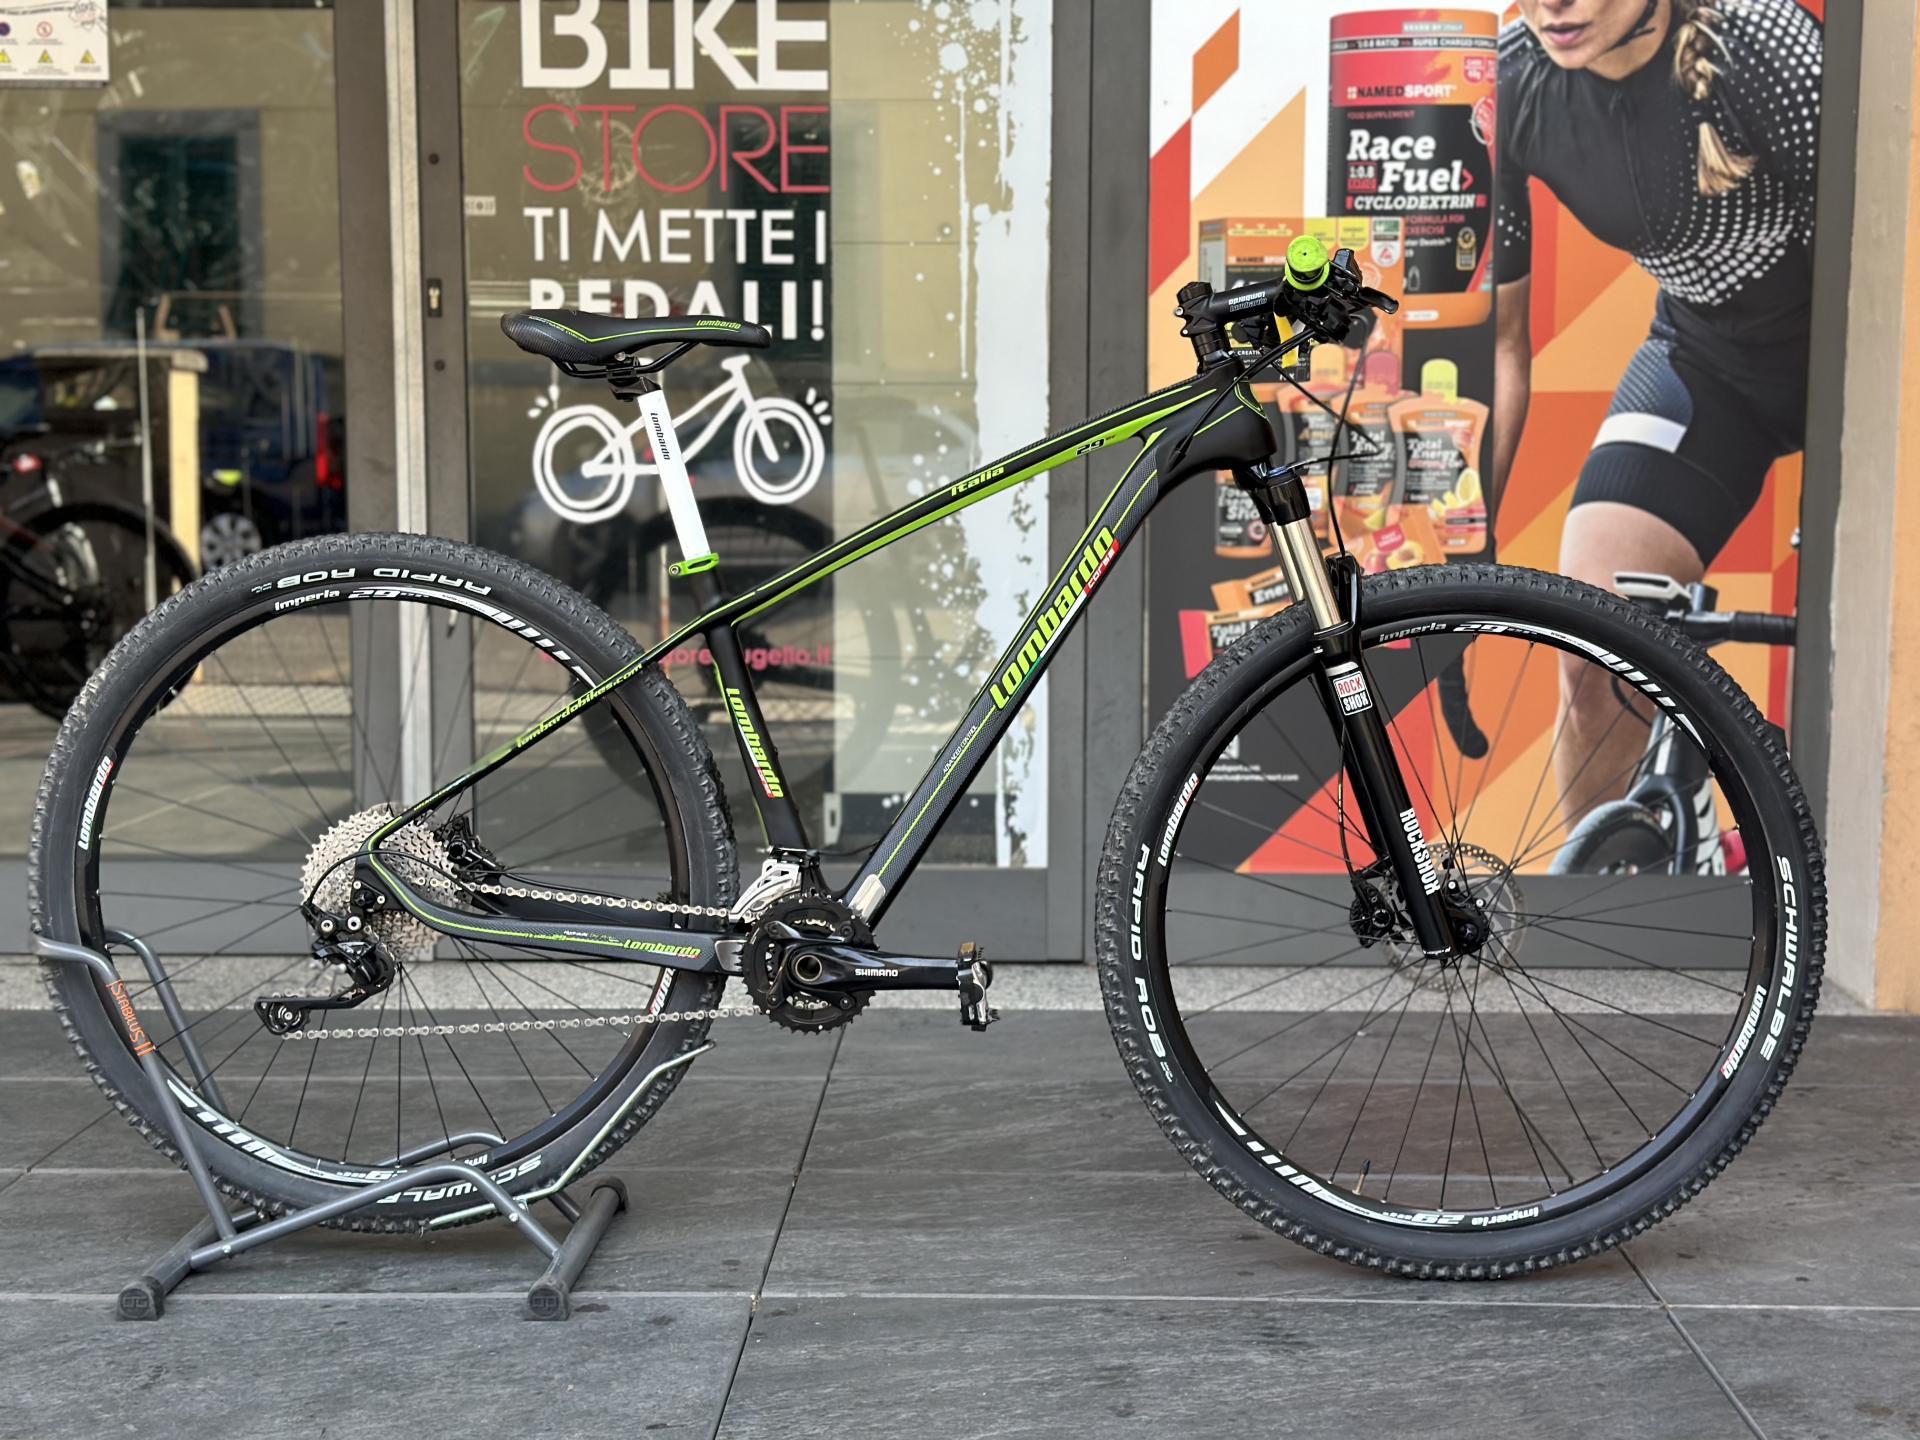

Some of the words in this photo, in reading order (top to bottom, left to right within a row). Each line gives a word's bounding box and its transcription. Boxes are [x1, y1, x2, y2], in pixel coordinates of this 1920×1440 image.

[520, 0, 829, 90] BIKE
[523, 103, 831, 193] STORE
[1346, 129, 1436, 161] Race
[1354, 194, 1476, 210] CYCLODEXTRIN
[523, 207, 569, 261] TI
[593, 209, 794, 264] METTE
[815, 210, 826, 264] I
[529, 278, 825, 342] PEDALI!
[951, 465, 1005, 497] Italia
[277, 568, 356, 591] ROB
[347, 589, 401, 599] 29
[373, 568, 492, 596] RAPID
[1452, 623, 1509, 634] 29
[1336, 680, 1363, 697] ROCK
[1342, 691, 1369, 712] SHOX
[1399, 808, 1441, 896] ROCKSHOX
[1130, 843, 1150, 961] RAPID
[854, 967, 899, 978] SHIMANO
[1759, 855, 1798, 1062] SCHWALBE
[1135, 977, 1167, 1060] ROB
